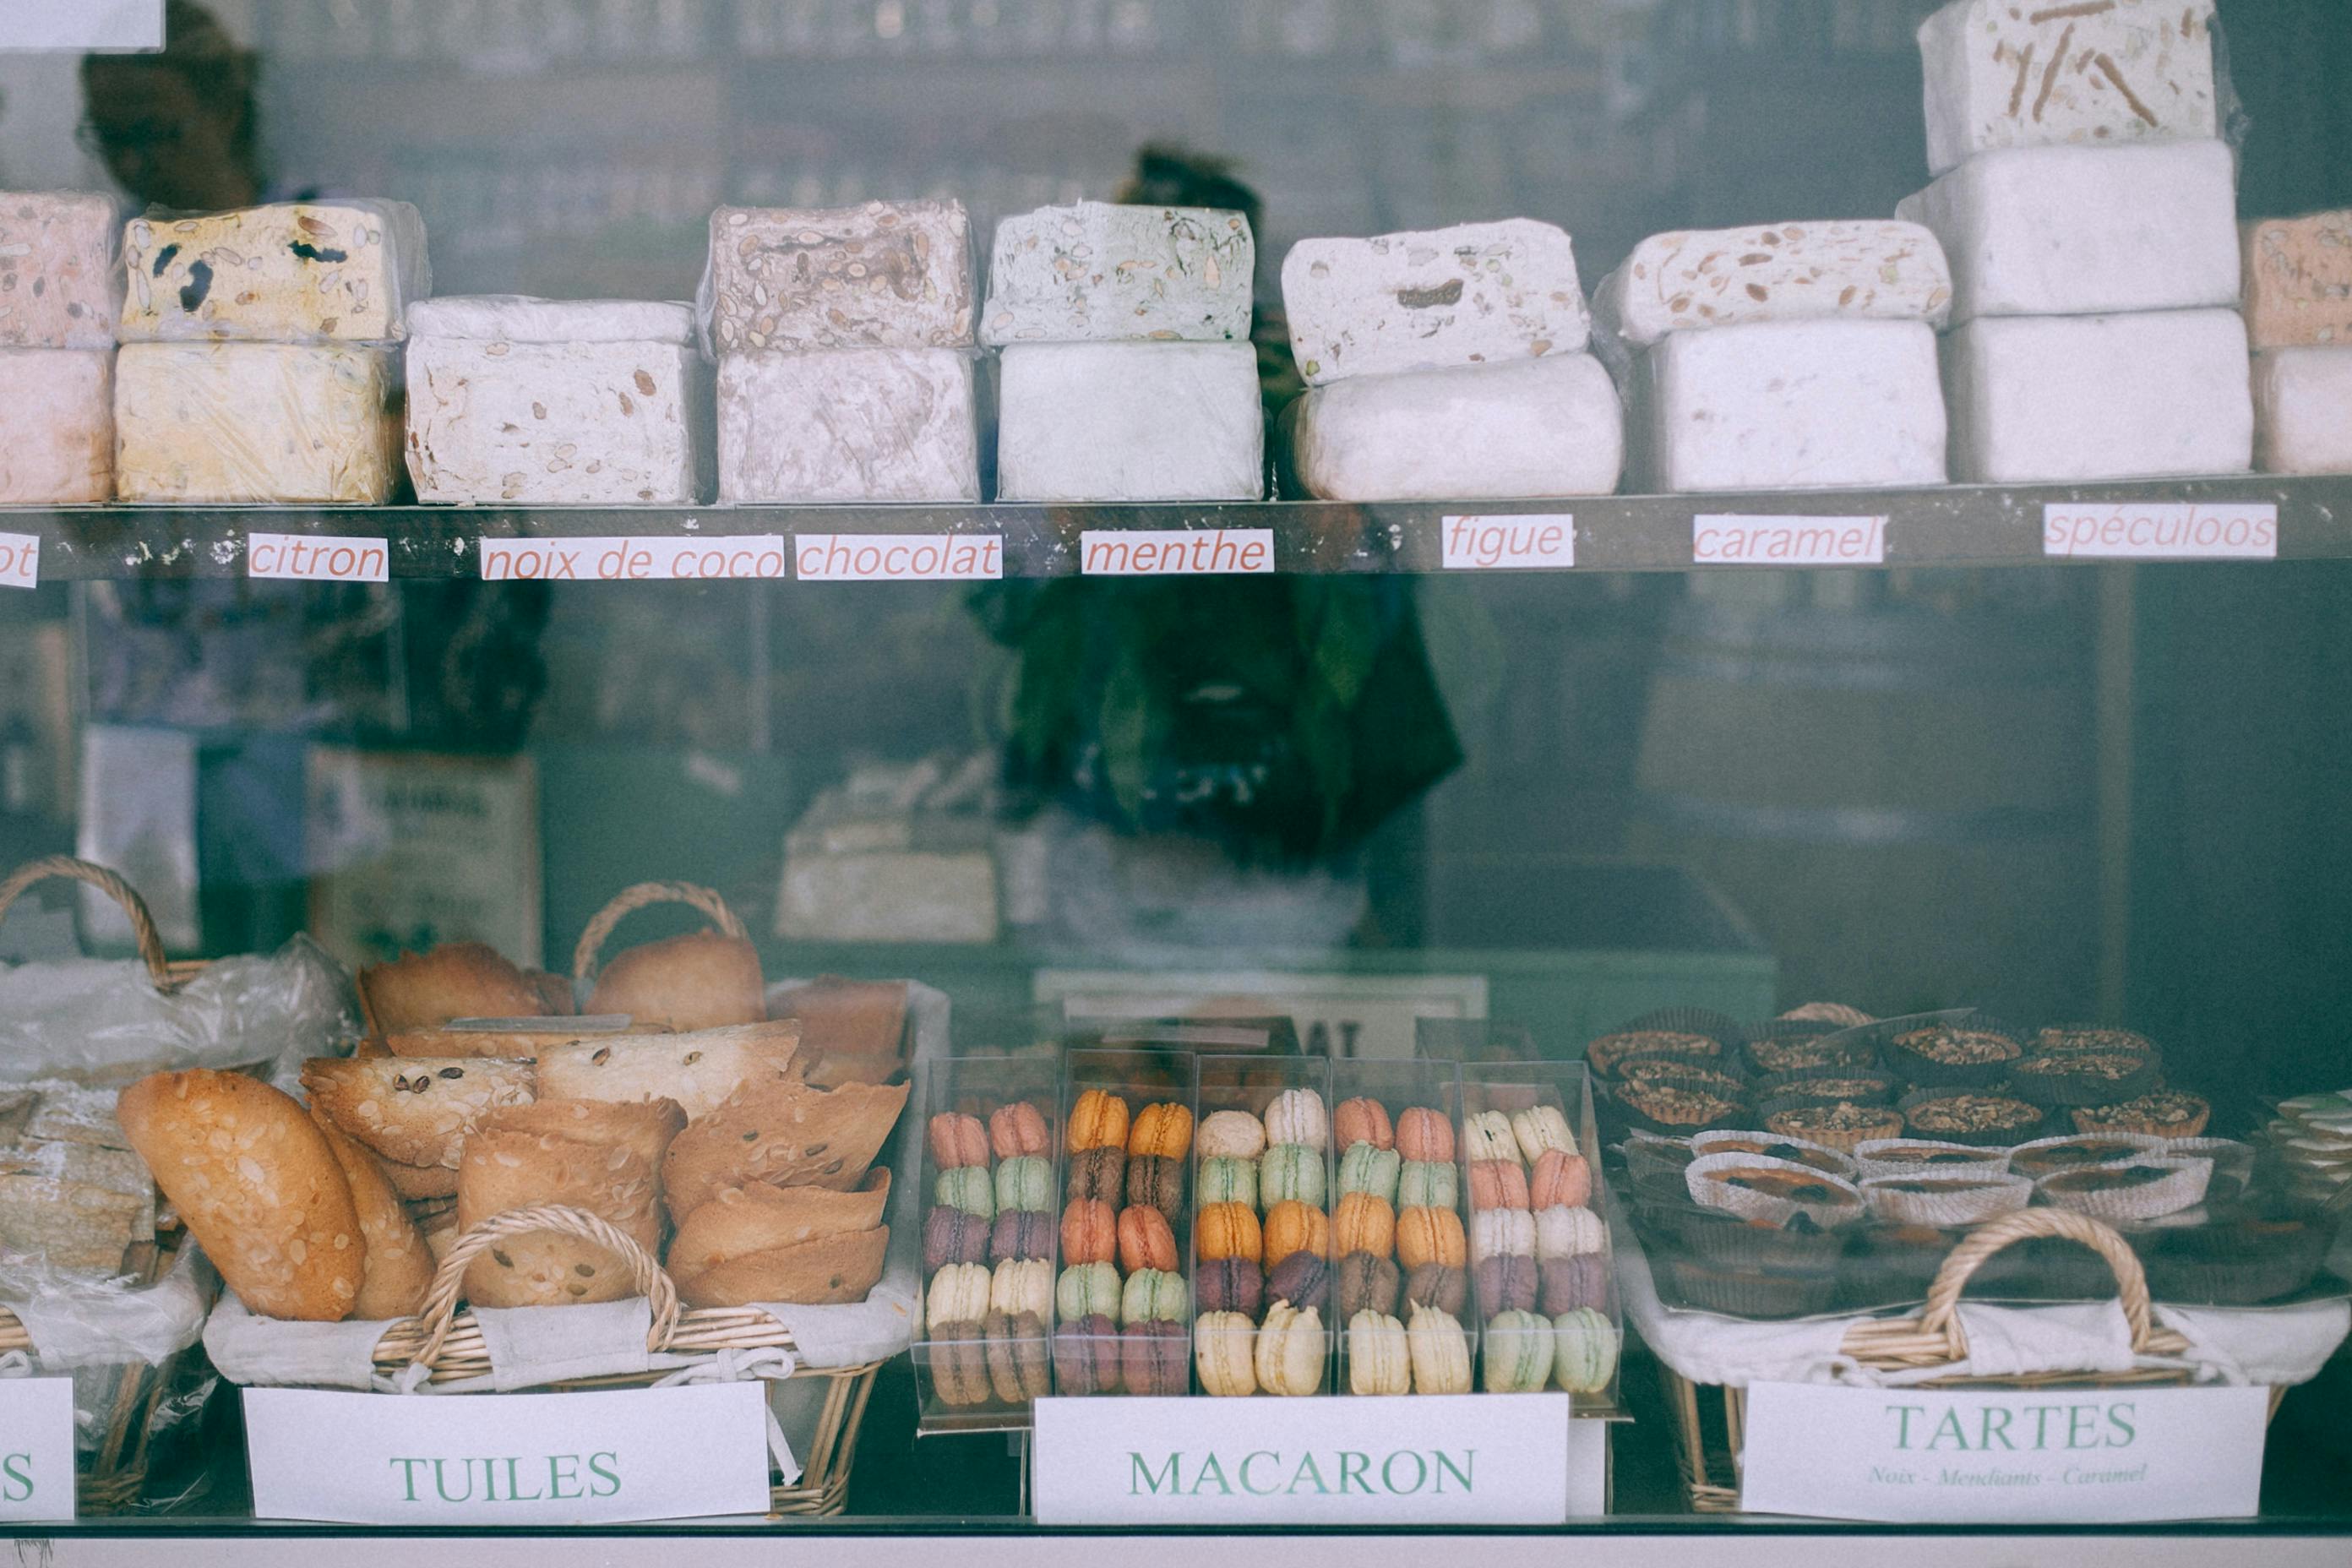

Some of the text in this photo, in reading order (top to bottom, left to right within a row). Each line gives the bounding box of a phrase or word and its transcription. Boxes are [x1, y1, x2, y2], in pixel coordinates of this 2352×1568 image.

[1449, 516, 1563, 566] figue
[1693, 518, 1877, 558] caramel
[2045, 505, 2274, 556] spéculoos
[250, 536, 384, 576] citron
[484, 540, 782, 579] noix de coco
[798, 536, 999, 575] chocolat
[1086, 531, 1266, 571] menthe
[1886, 1402, 2137, 1451] TARTES
[389, 1451, 622, 1502] TUILES
[1126, 1449, 1478, 1495] MACARON
[1869, 1465, 1916, 1485] Noix
[1938, 1466, 2042, 1487] Mendiants
[2062, 1462, 2148, 1485] Caramel
